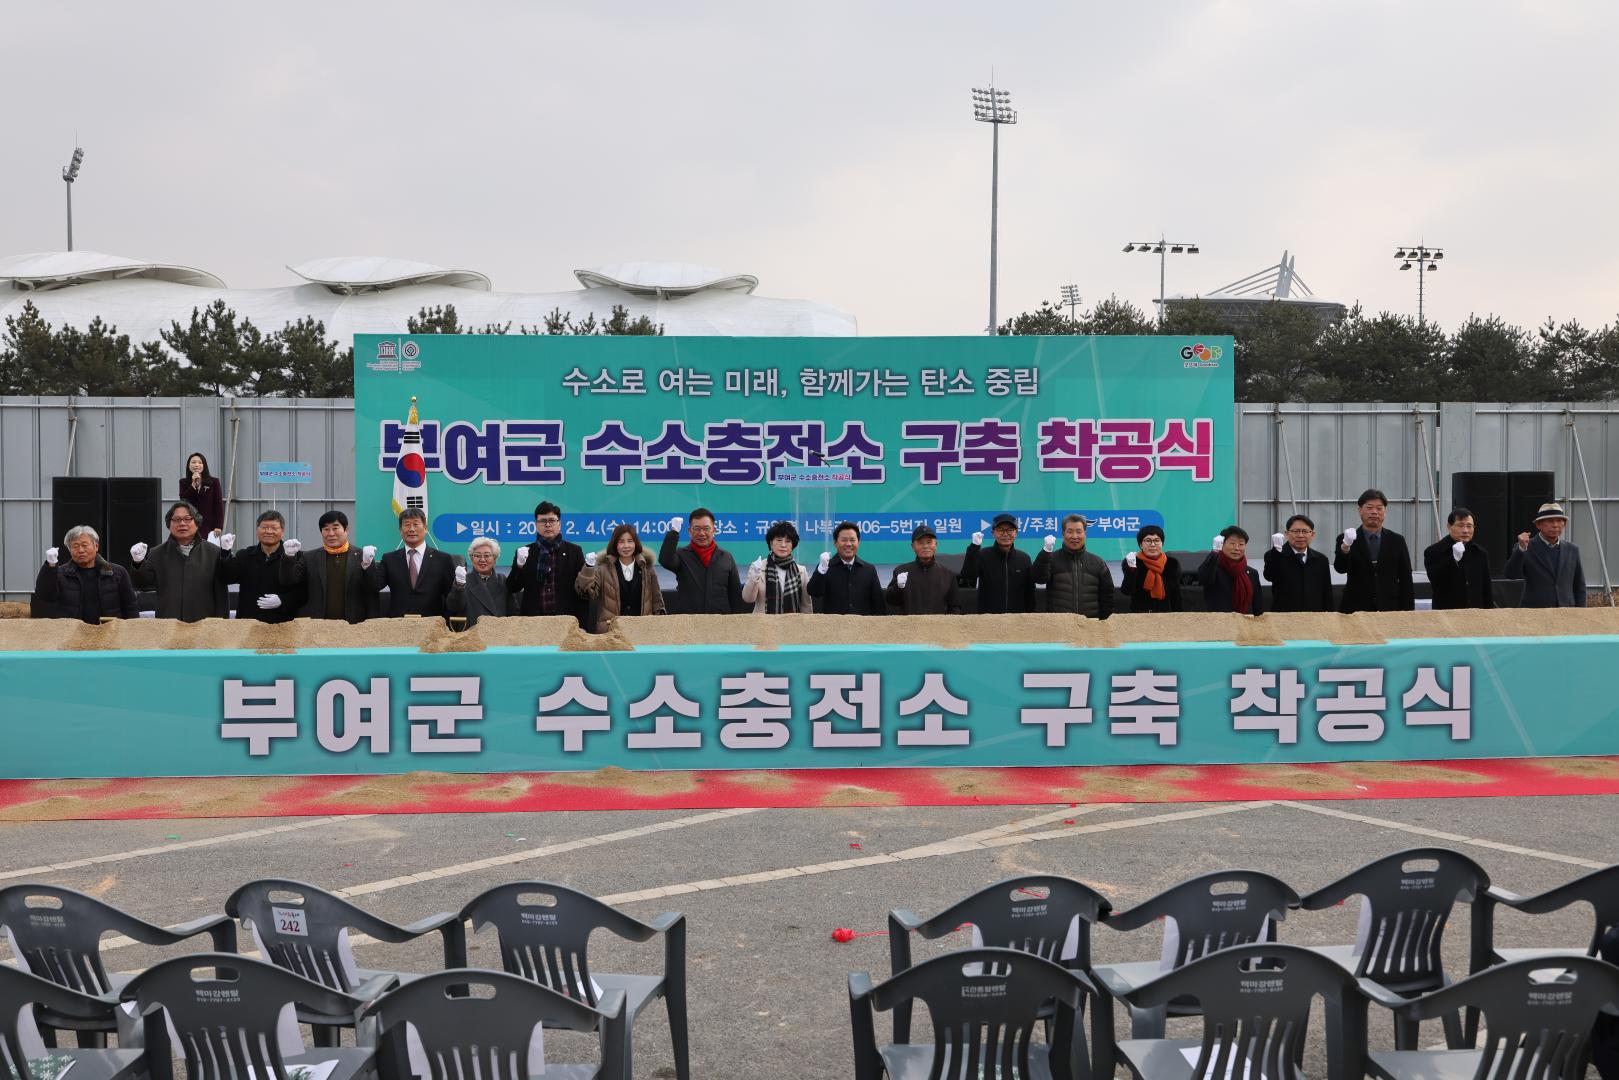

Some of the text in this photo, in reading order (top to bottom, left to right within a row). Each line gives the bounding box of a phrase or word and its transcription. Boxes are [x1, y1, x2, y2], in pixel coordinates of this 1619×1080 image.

[562, 367, 1038, 397] 수소로 여는 미래, 함께가는 탄소 중립
[379, 417, 1214, 485] 부여군 수소충전소 구축 착공식
[470, 520, 500, 536] 일시
[565, 521, 580, 535] 2.
[933, 518, 963, 534] 일원
[1098, 517, 1141, 532] 부여군
[221, 666, 1471, 755] 부여군 수소충전소 구축 착공식
[281, 919, 300, 932] 242
